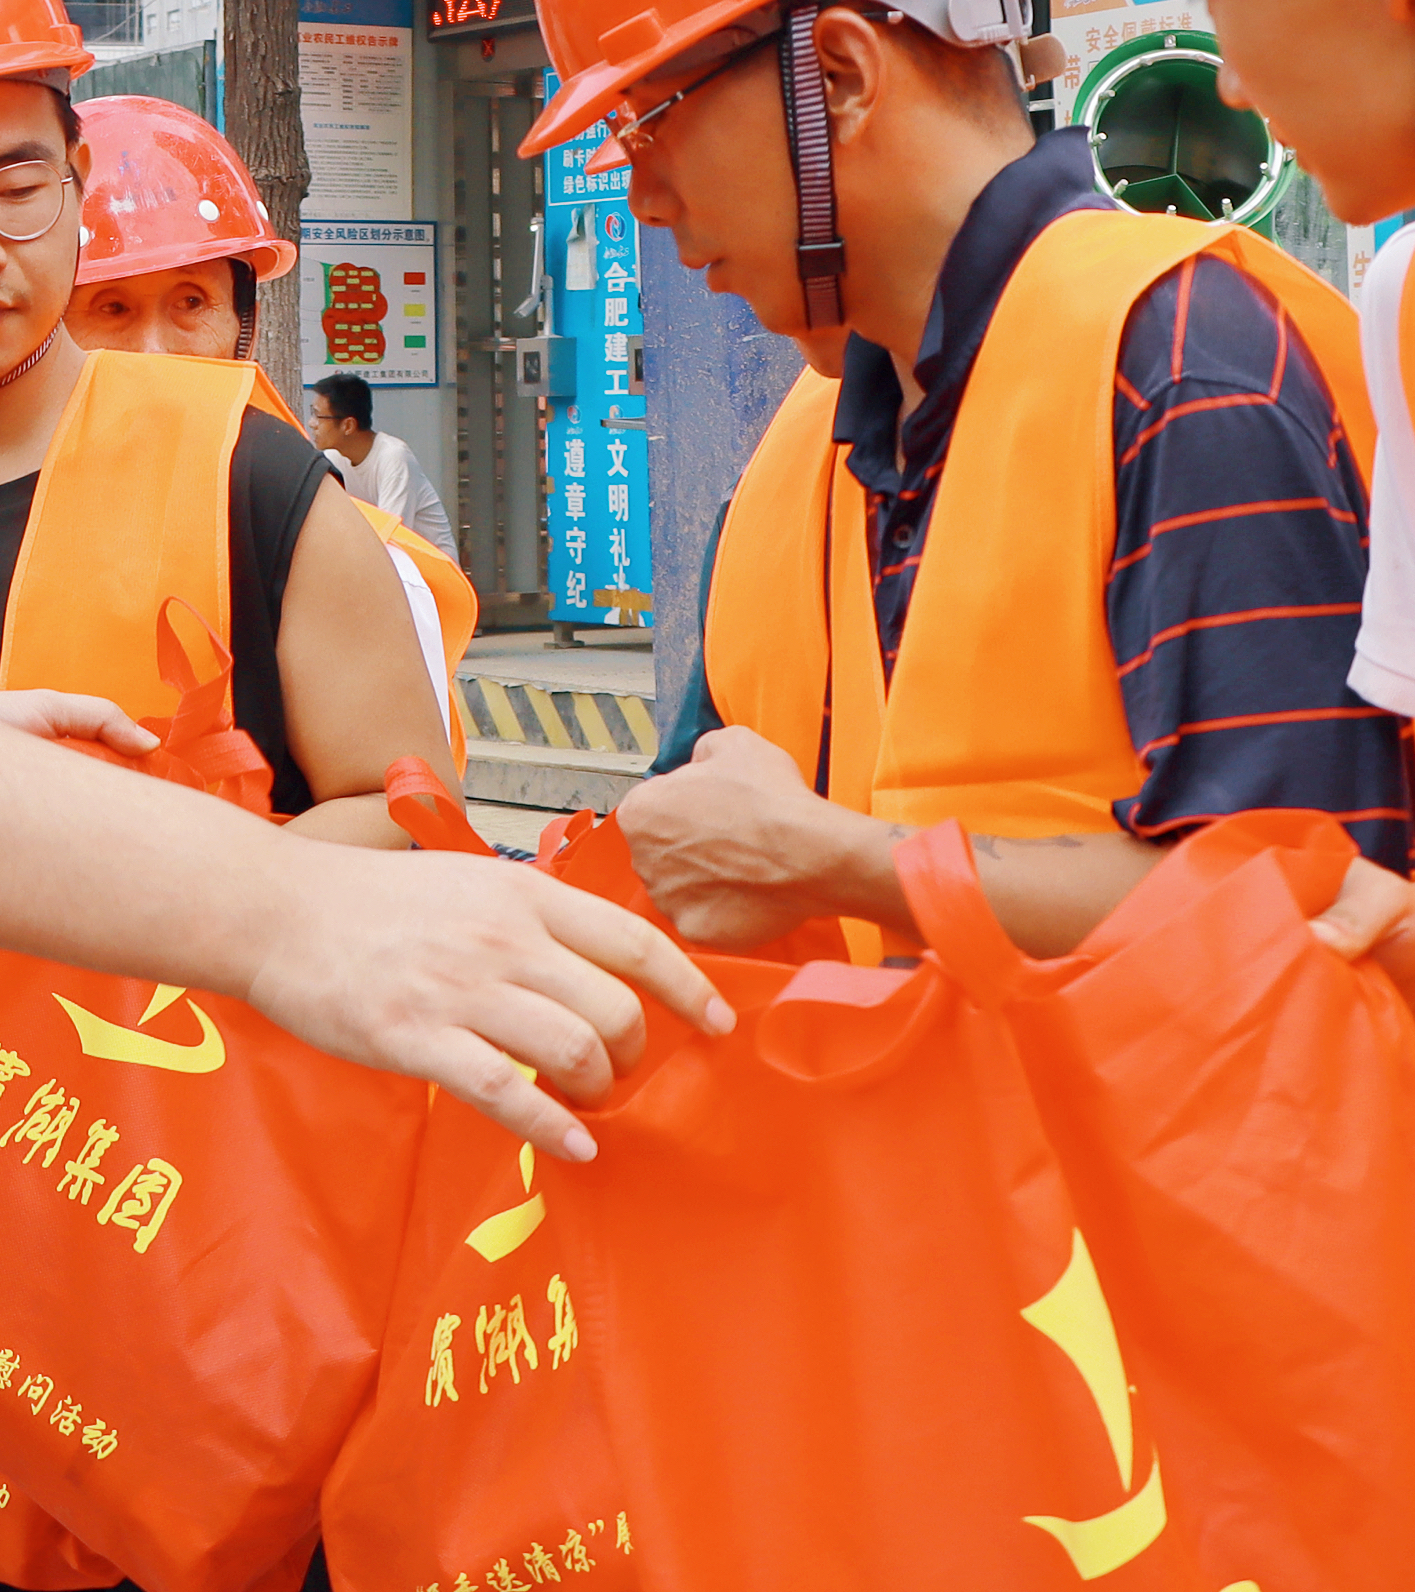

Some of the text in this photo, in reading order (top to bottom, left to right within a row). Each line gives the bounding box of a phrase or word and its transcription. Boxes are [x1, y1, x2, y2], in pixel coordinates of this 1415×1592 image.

[603, 261, 637, 396] 合肥建工
[563, 438, 588, 609] 遵章守纪
